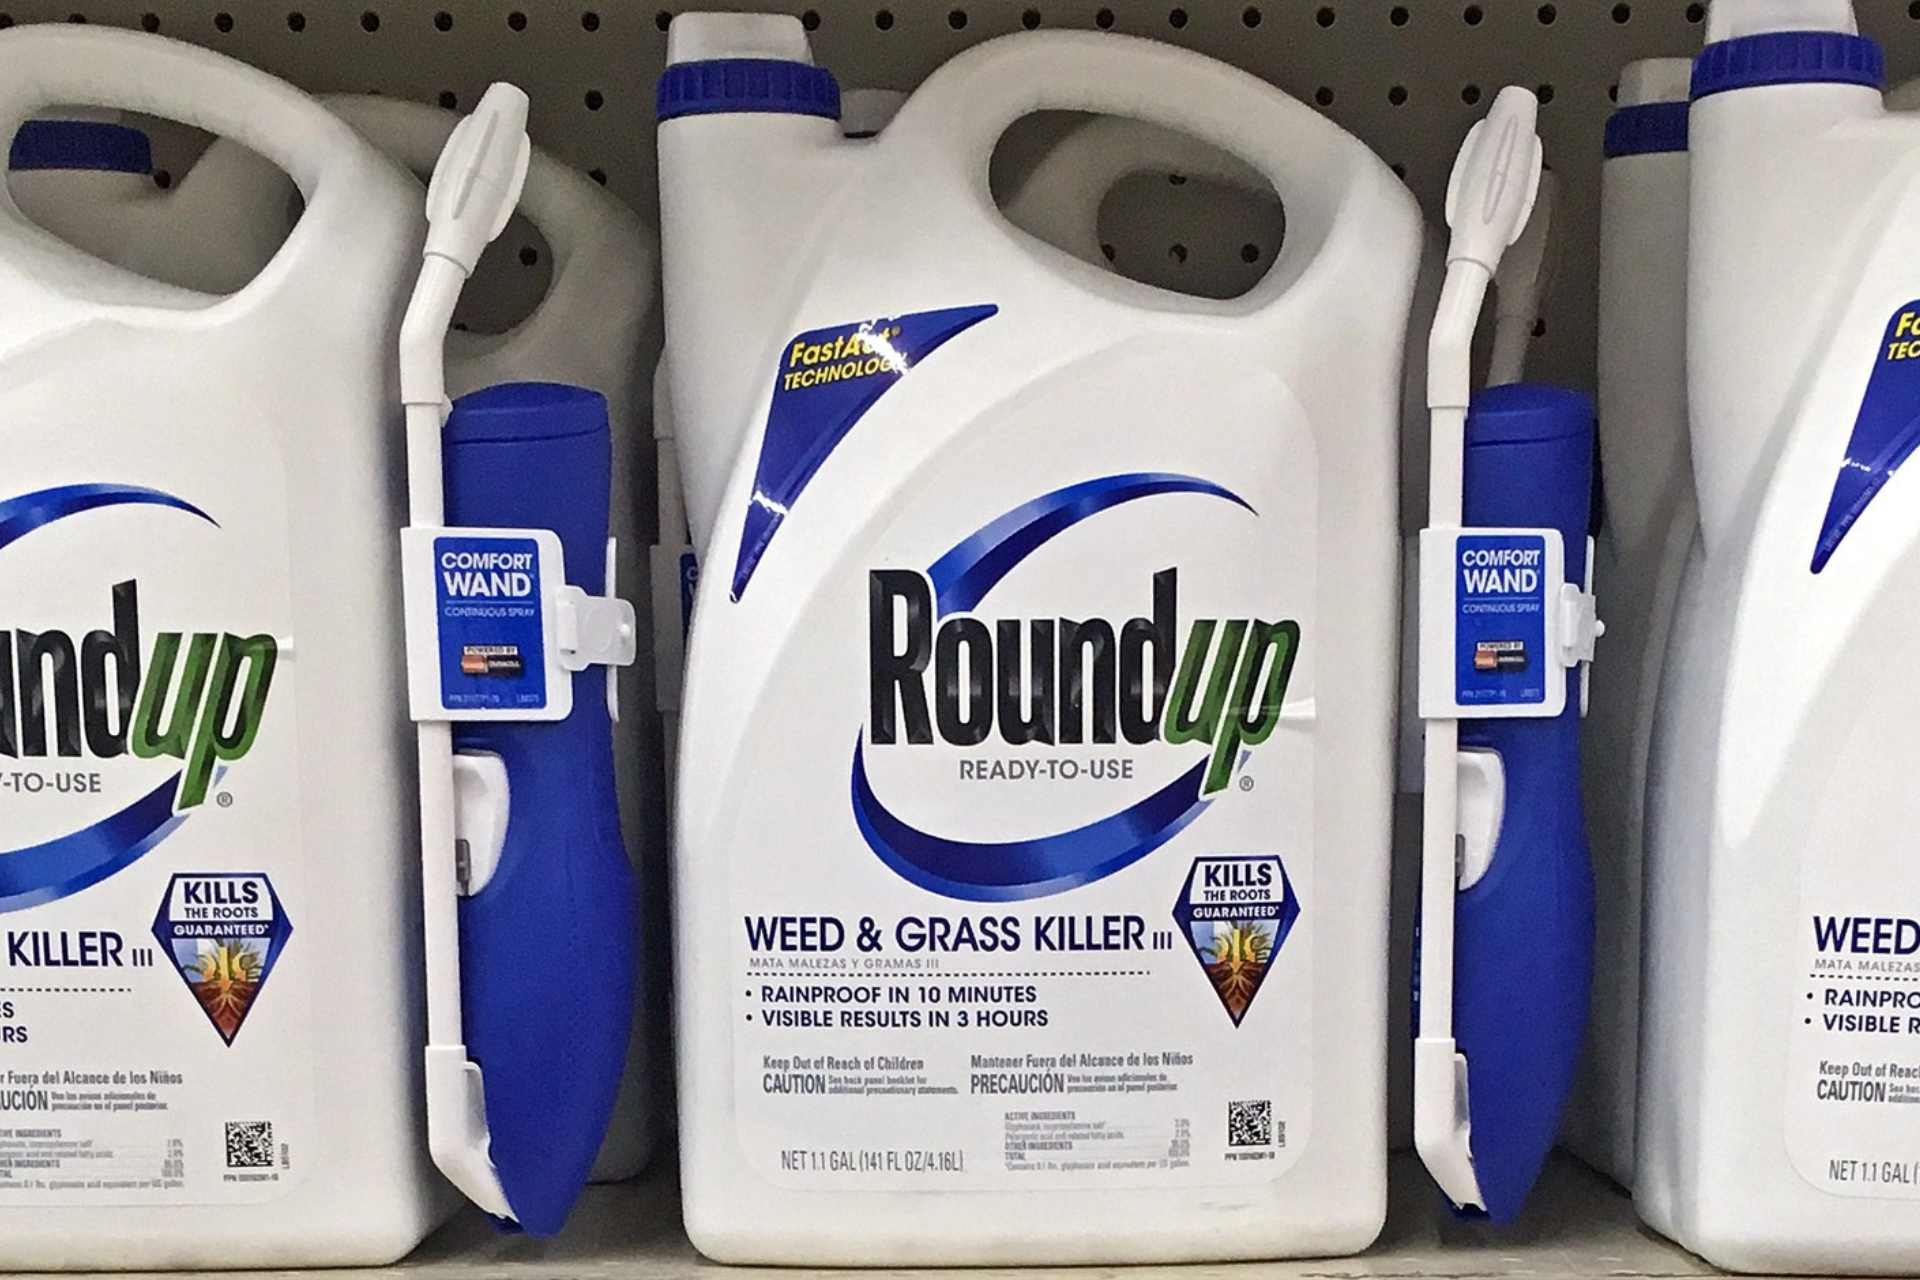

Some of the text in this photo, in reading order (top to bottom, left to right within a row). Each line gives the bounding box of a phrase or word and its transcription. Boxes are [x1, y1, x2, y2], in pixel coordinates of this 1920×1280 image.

[784, 352, 907, 391] TECHNOLOG
[441, 552, 533, 570] COMFORT
[1462, 550, 1540, 567] COMFORT
[443, 572, 532, 597] WAND
[1463, 569, 1538, 593] WAND
[444, 607, 535, 617] CONTINUOUS SPRAY
[869, 567, 1301, 795] Roundup
[959, 759, 1134, 780] READY-TO-USE
[1203, 862, 1272, 887] KILLS
[183, 881, 259, 905] KILLS
[1204, 888, 1272, 902] THE ROOTS
[184, 907, 258, 919] THE ROOTS
[744, 915, 1173, 952] WEED & GRASS KILLER III
[1813, 915, 1920, 955] WEED
[7, 931, 153, 967] KILLER III
[749, 958, 784, 969] MATA
[788, 958, 847, 969] MALEZAS
[851, 958, 860, 969] Y
[863, 958, 922, 970] GRAMAS
[1814, 958, 1851, 970] MATA
[761, 986, 1037, 1003] RAINPROOF IN 10 MINUTES
[761, 1010, 1049, 1027] VISIBLE RESULTS IN 3 HOURS
[1823, 1013, 1901, 1033] VISIBLE
[763, 1055, 924, 1072] Keep Out of Reach of Children
[970, 1052, 1194, 1069] Mantener Fuera del Alcance de los Niños
[1818, 1060, 1920, 1079] Keep Out of Reac
[8, 1070, 39, 1084] Fuera
[42, 1070, 60, 1084] del
[63, 1070, 110, 1084] Alcance
[112, 1071, 127, 1084] de
[130, 1070, 147, 1084] los
[150, 1070, 184, 1084] Niños
[762, 1074, 827, 1094] CAUTION
[970, 1067, 1065, 1094] PRECAUCIÓN
[0, 1084, 48, 1110] UCIÓN
[1817, 1079, 1887, 1102] CAUTION
[781, 1149, 964, 1172] NET 1.1 GAL (141 FL OZ/4.16L)
[1829, 1159, 1858, 1181] NET
[1862, 1162, 1877, 1182] 1.1
[1881, 1161, 1910, 1183] GAL
